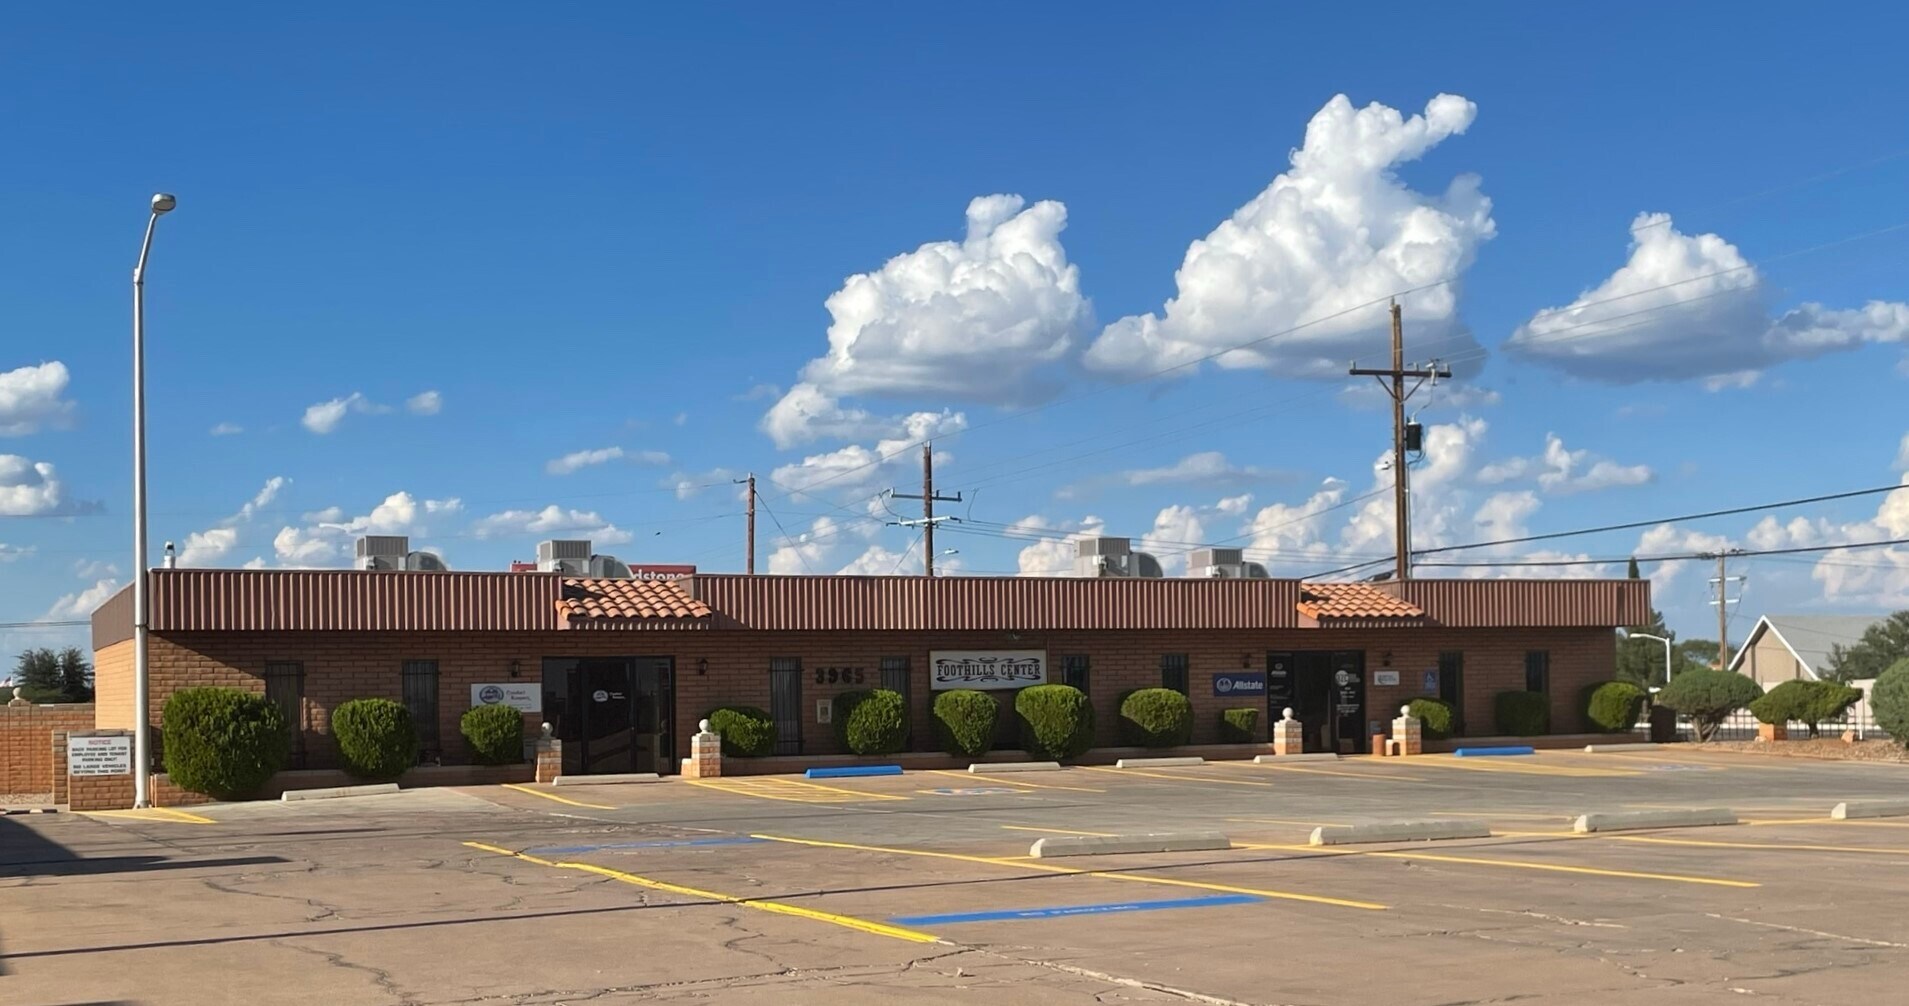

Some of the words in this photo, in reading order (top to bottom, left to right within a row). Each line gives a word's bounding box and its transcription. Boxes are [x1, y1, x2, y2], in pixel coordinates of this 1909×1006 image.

[815, 667, 865, 684] 3965
[937, 664, 995, 677] FOOTHILLS
[1000, 663, 1041, 676] CENTER
[1232, 680, 1264, 690] Allstate
